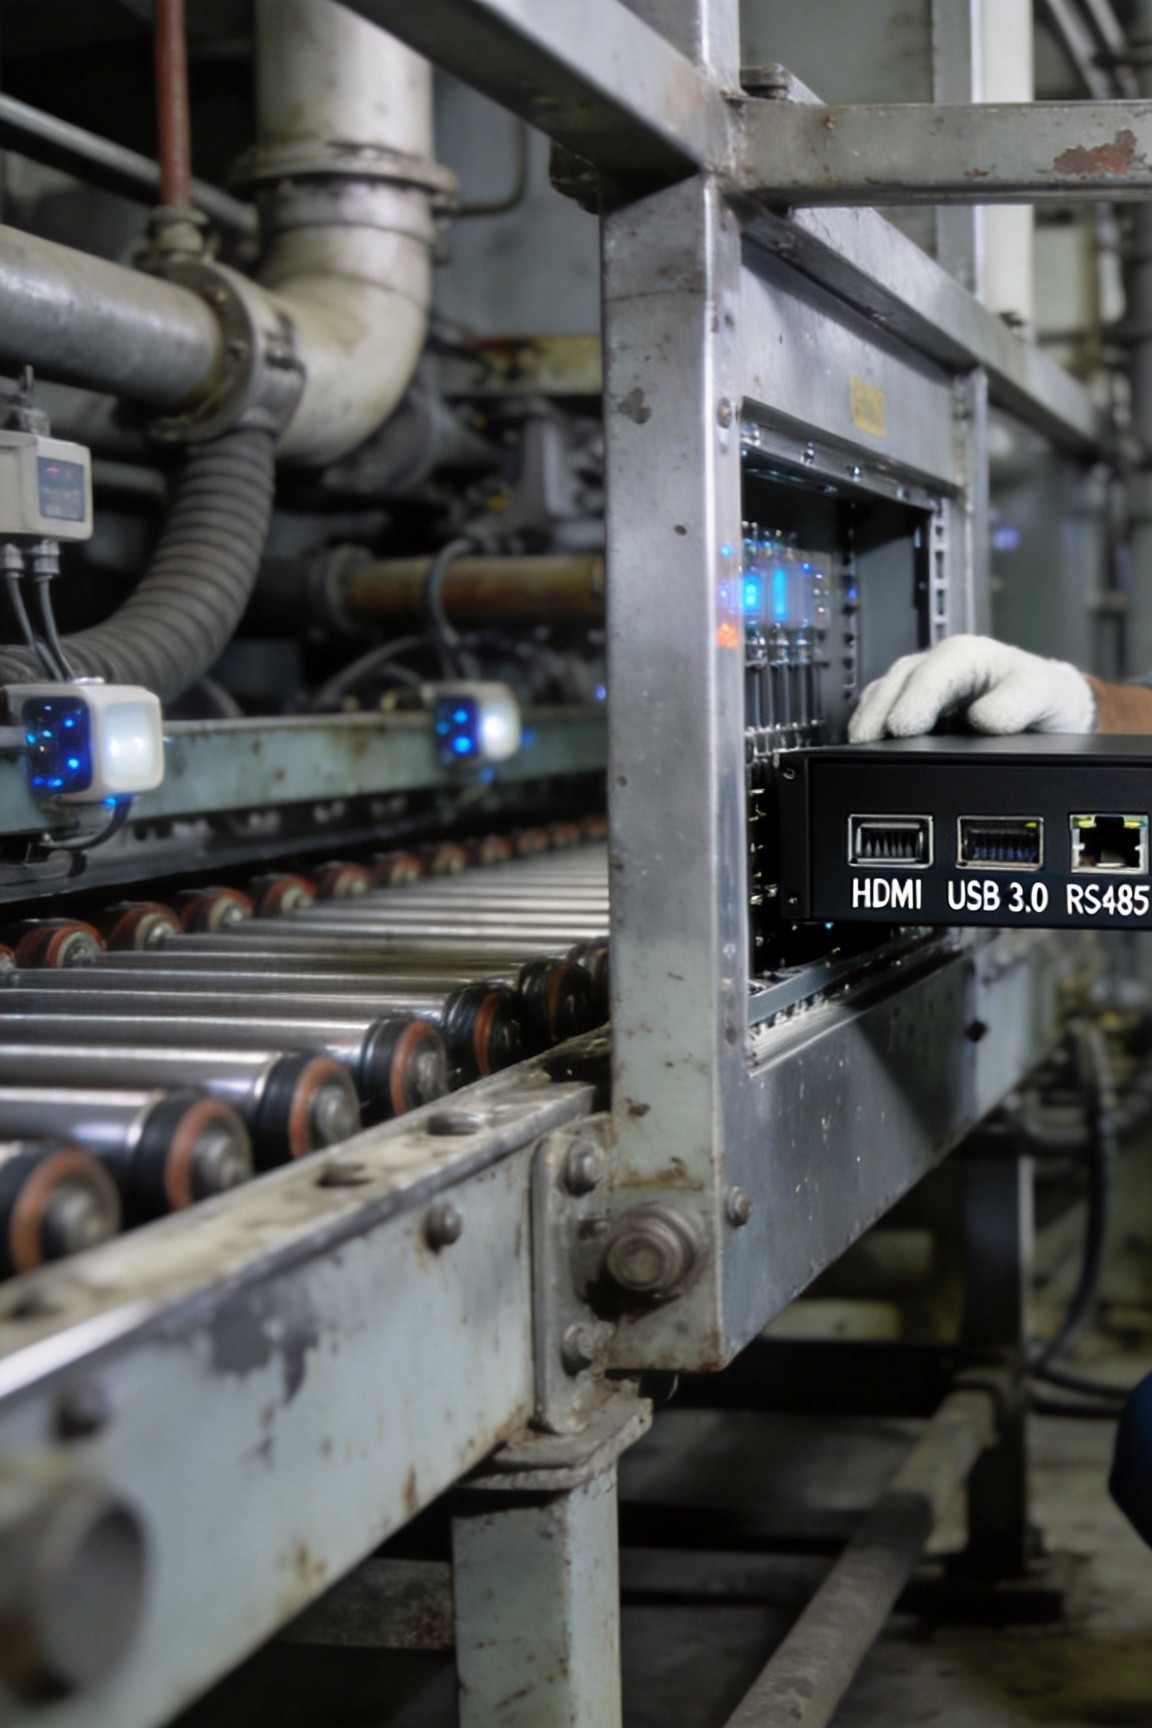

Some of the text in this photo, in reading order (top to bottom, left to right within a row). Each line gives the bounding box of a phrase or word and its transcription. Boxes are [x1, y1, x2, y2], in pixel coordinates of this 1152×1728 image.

[852, 878, 922, 910] HDMI
[947, 880, 1049, 914] USB 3.0
[1066, 883, 1151, 917] RS485
